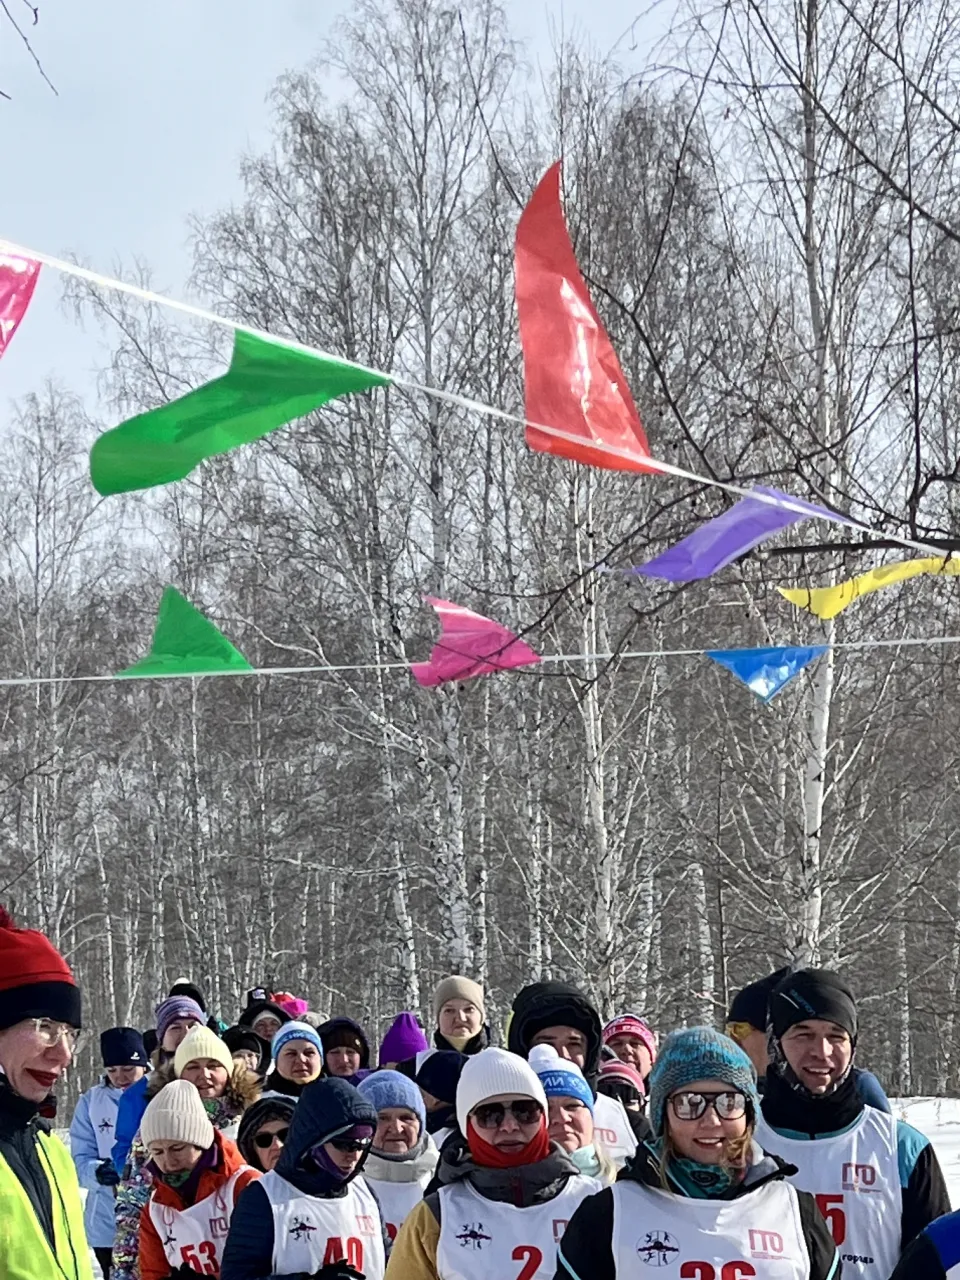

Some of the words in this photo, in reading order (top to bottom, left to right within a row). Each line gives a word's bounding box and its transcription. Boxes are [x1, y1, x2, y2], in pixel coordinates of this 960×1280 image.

[842, 1162, 876, 1186] ГТО
[815, 1193, 846, 1247] 5
[322, 1236, 365, 1274] 40
[748, 1228, 784, 1253] ГТО
[180, 1241, 220, 1274] 53
